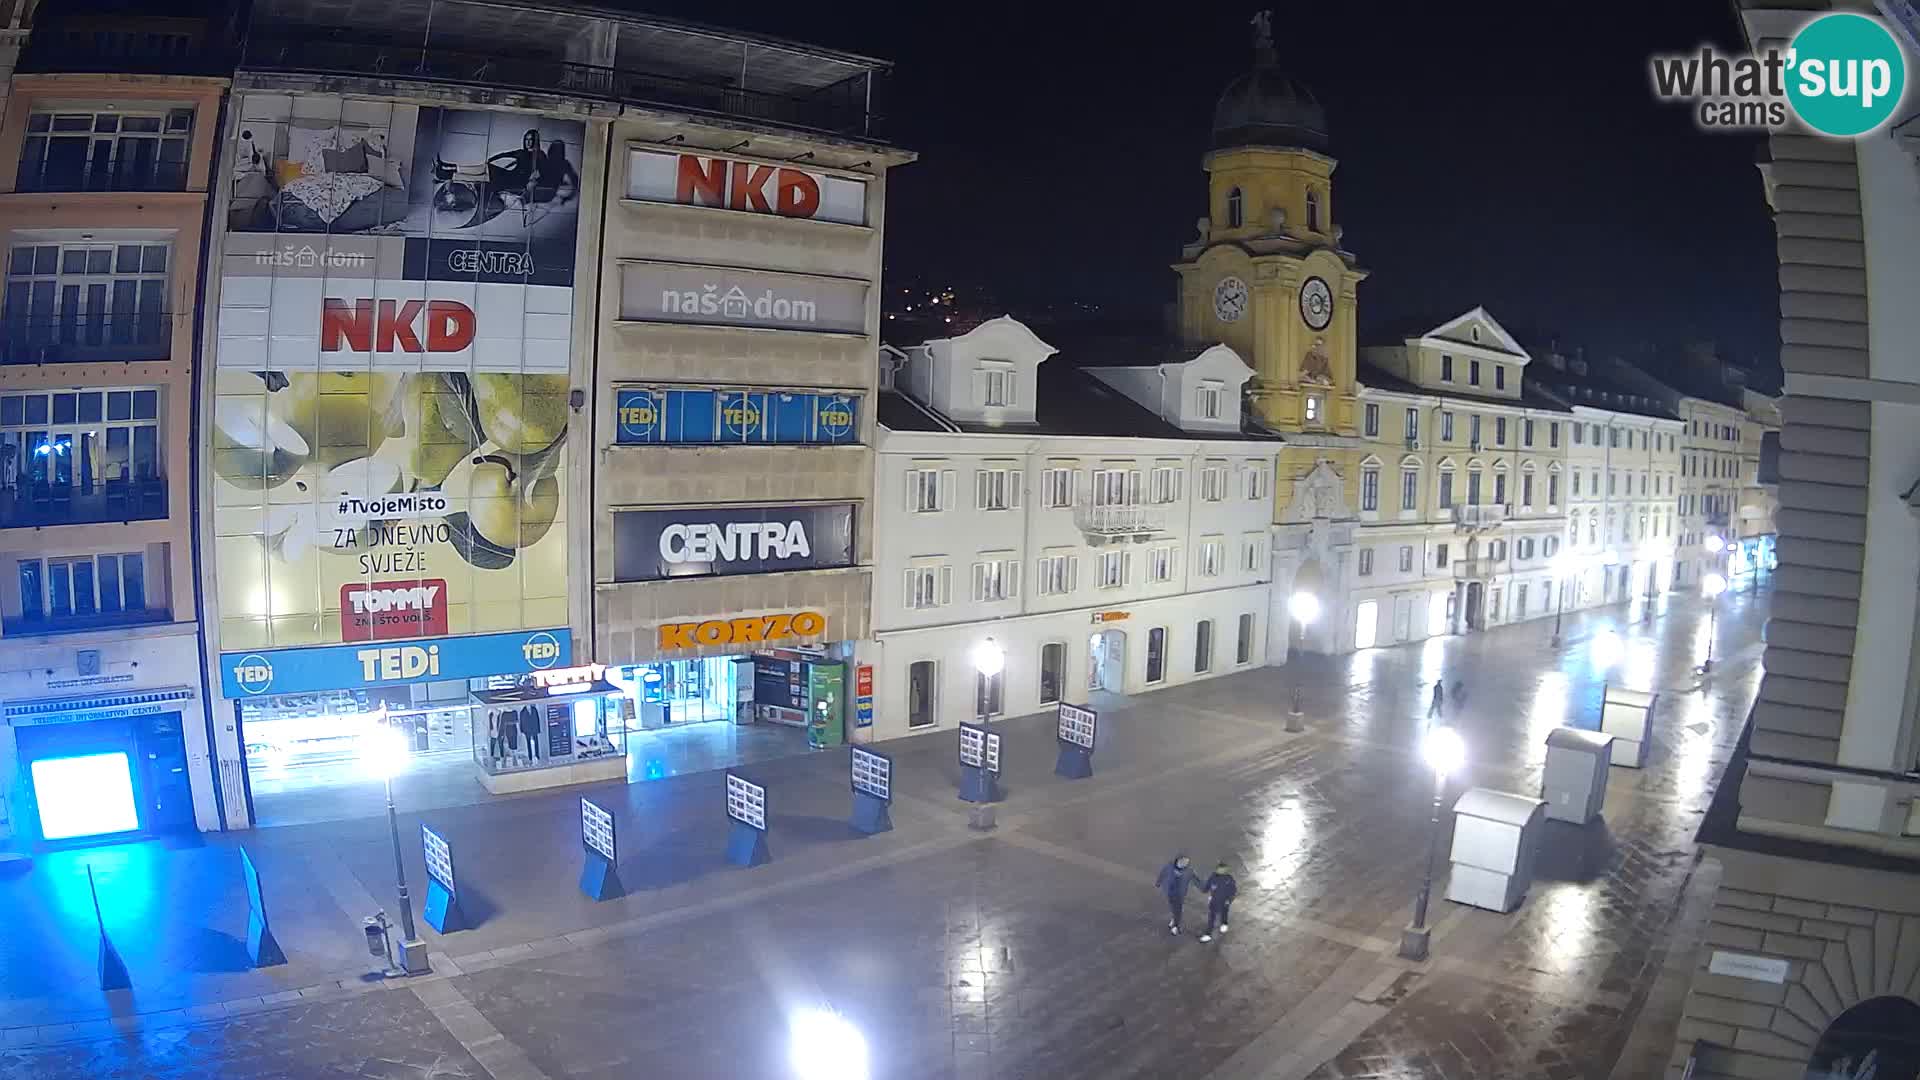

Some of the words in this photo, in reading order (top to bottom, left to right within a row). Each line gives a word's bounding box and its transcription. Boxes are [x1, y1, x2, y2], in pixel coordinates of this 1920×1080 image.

[675, 154, 820, 219] NKD
[255, 245, 294, 268] naš
[320, 246, 365, 268] dom
[448, 249, 535, 275] CENTRA
[661, 284, 718, 316] naš
[754, 289, 817, 323] dom
[320, 297, 477, 353] NKD
[338, 497, 446, 516] #TvojeMisto
[334, 528, 358, 548] ZA
[368, 523, 451, 547] DNEVNO
[659, 520, 811, 563] CENTRA
[359, 548, 427, 575] SVJEŽE
[348, 586, 440, 614] TOMMY
[659, 612, 825, 650] KORZO
[358, 645, 440, 682] TEDi
[522, 643, 560, 661] TEDi
[233, 665, 274, 683] TEDi
[533, 663, 606, 688] TOMMY
